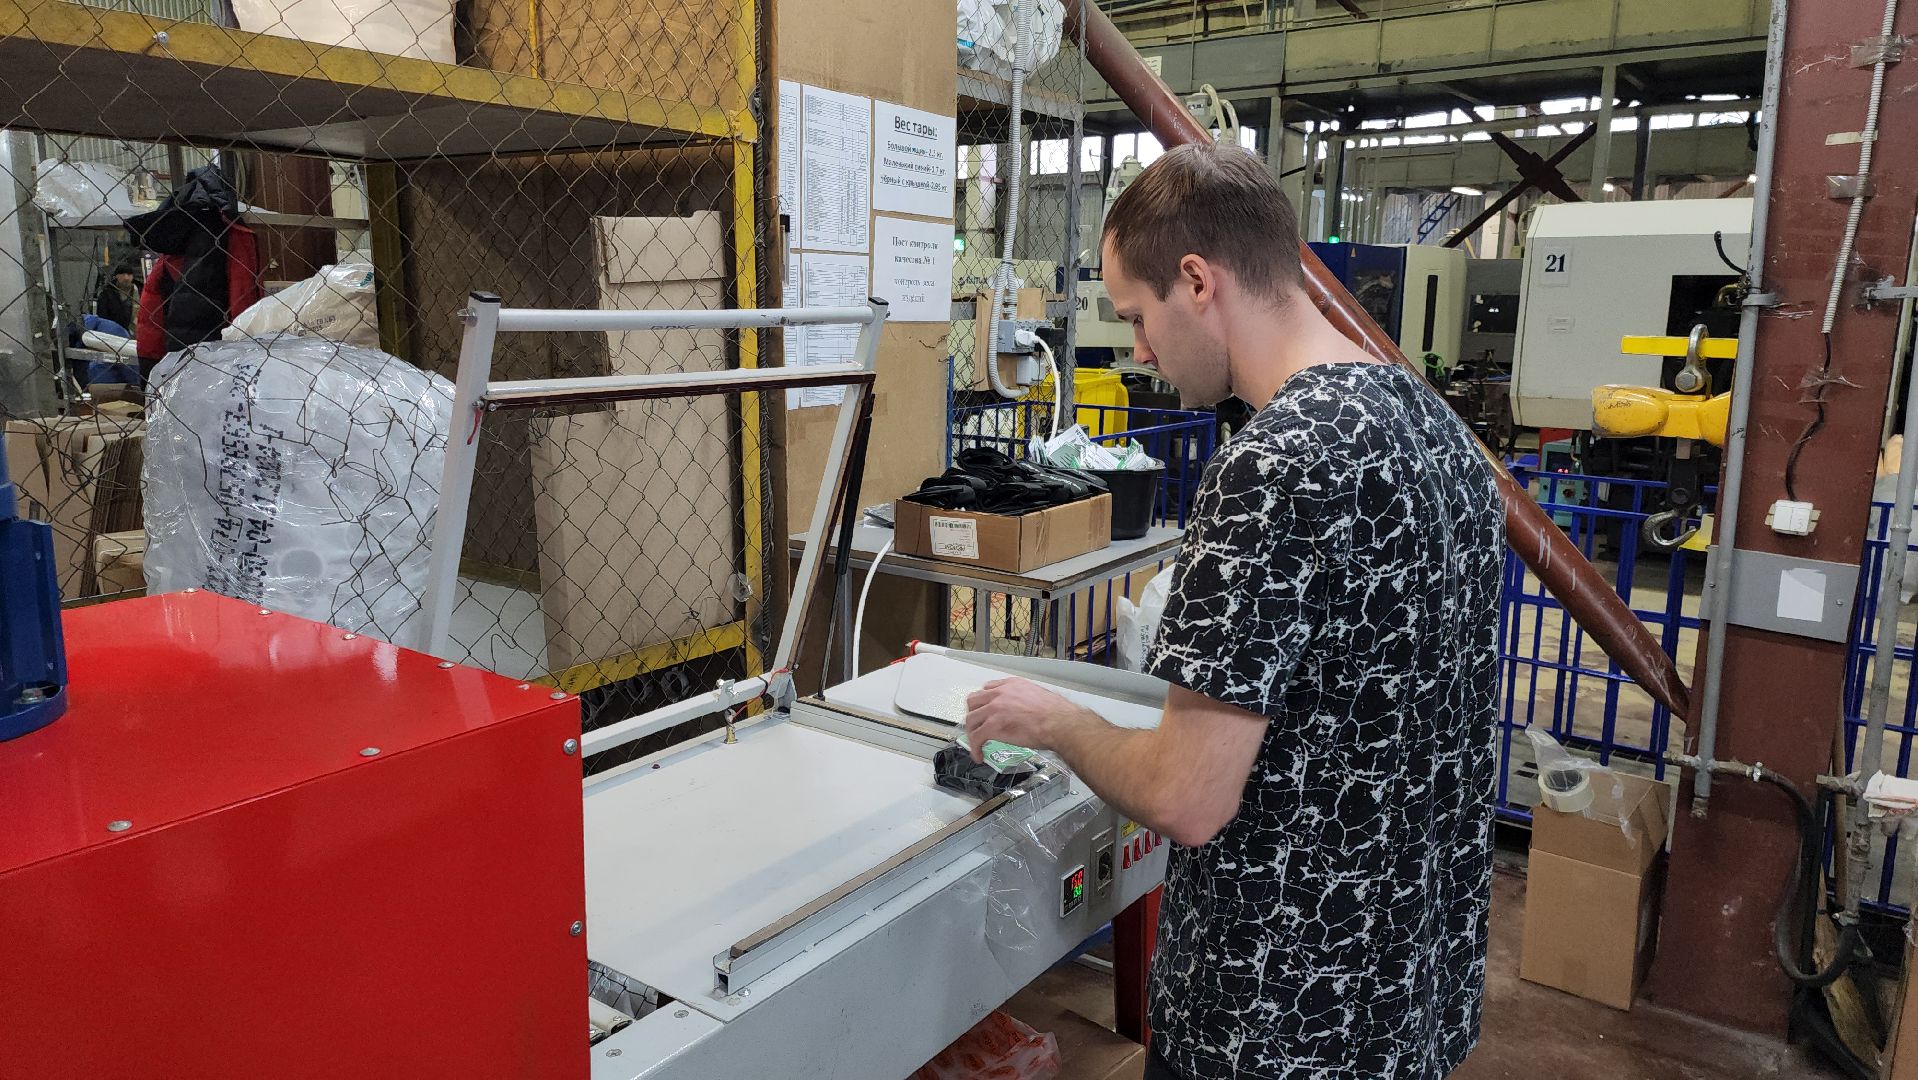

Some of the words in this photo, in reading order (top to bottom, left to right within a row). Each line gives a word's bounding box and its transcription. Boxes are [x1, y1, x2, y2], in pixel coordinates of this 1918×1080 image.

[894, 115, 910, 131] Вес
[912, 122, 938, 137] тары:
[887, 140, 911, 153] Большой
[883, 157, 914, 170] Маленький
[892, 236, 908, 247] Пост
[909, 241, 939, 251] контроля
[1544, 253, 1566, 273] 21
